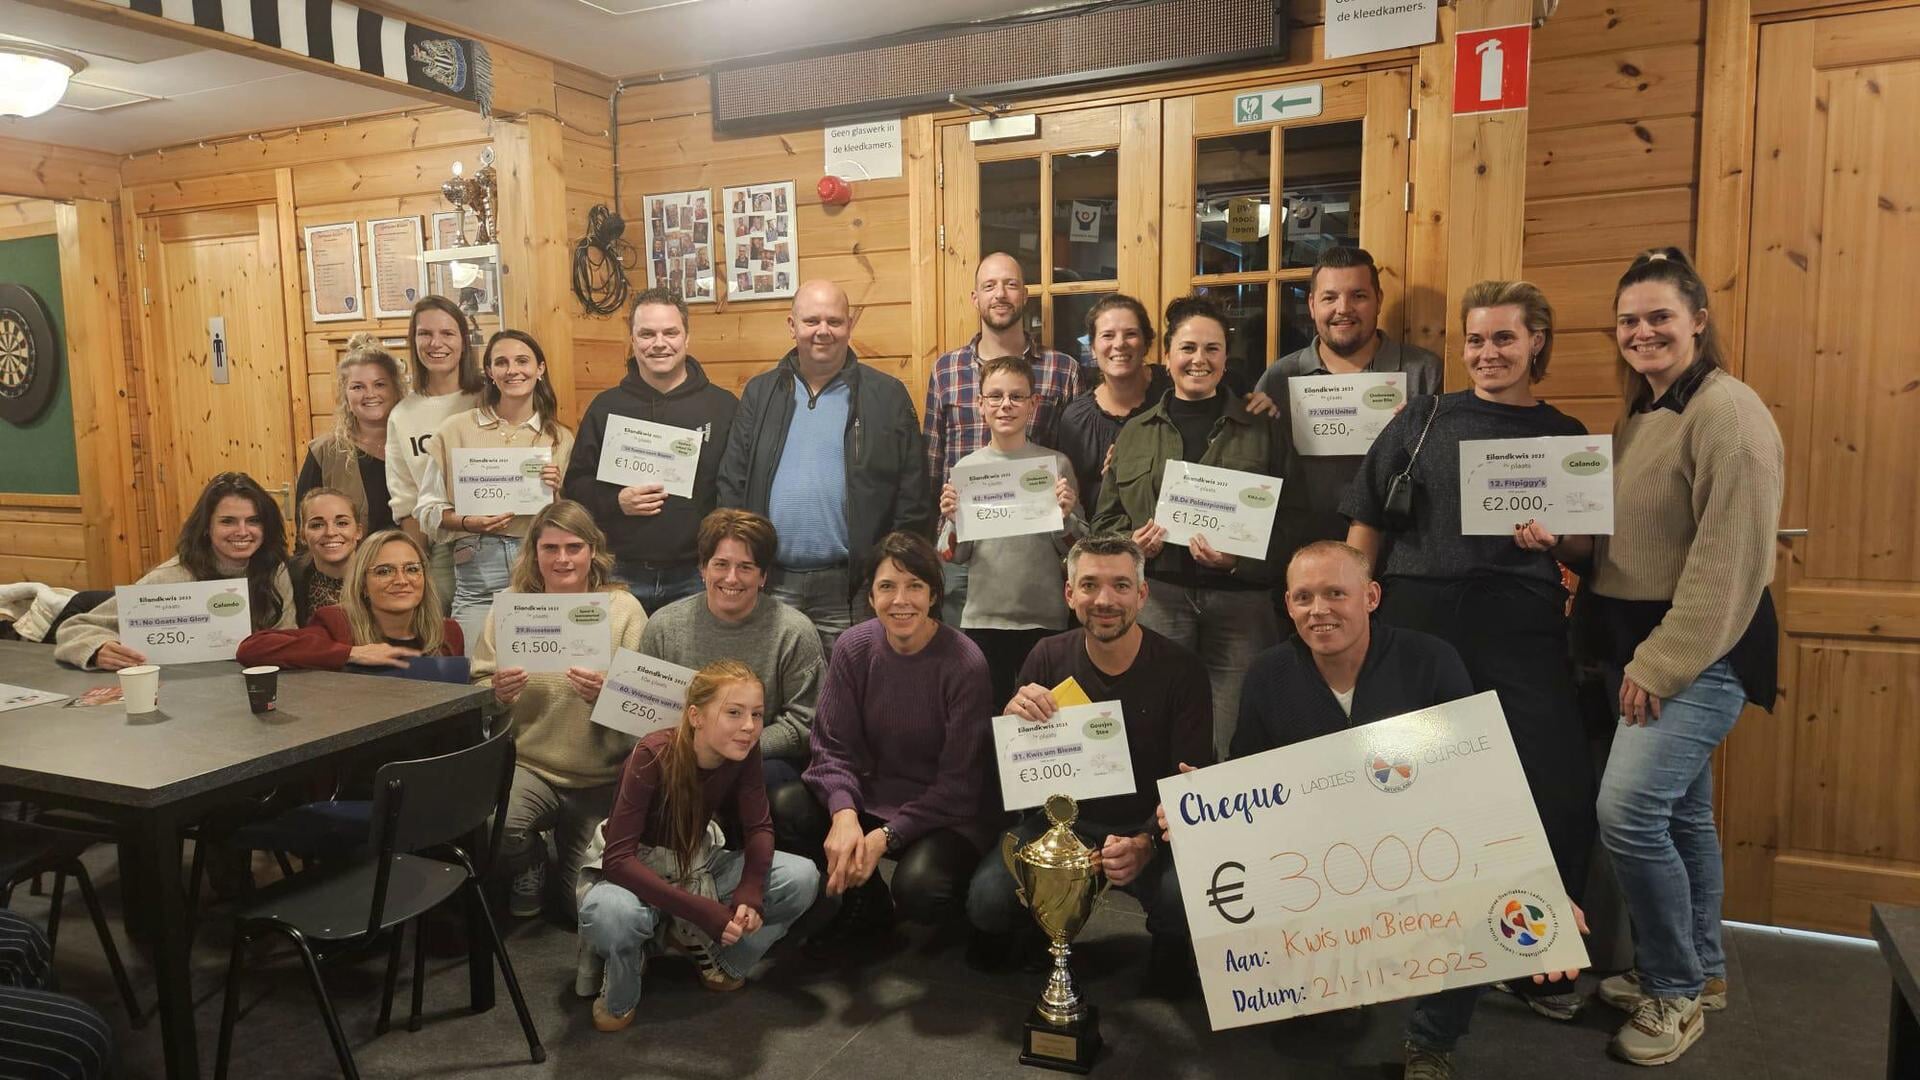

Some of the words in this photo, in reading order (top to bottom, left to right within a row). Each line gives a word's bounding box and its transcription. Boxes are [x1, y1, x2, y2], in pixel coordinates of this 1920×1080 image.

[1336, 12, 1350, 22] de
[1353, 2, 1426, 19] kleedkamers.
[1242, 113, 1258, 122] AED
[831, 129, 850, 138] Geen
[852, 124, 884, 137] glaswerk
[887, 122, 895, 132] in
[833, 145, 842, 154] de
[844, 141, 894, 152] kleedkamers.
[1313, 423, 1355, 436] €250,-
[615, 457, 660, 475] €1.000,-
[1505, 480, 1546, 488] Fitpiggy's
[474, 488, 510, 500] €250,-
[1483, 496, 1554, 512] €2.000,-
[976, 508, 1015, 520] €250,-
[1172, 511, 1224, 531] €1.250,-
[190, 616, 208, 624] Glory
[147, 632, 194, 644] €250,-
[512, 641, 566, 654] €1.500,-
[637, 666, 673, 682] Eilandkwis
[621, 700, 662, 723] €250,-
[1018, 724, 1054, 733] Eilandkwis
[1026, 752, 1043, 760] Kwis
[1020, 763, 1080, 782] €3.000,-
[1180, 783, 1291, 825] Cheque
[1424, 736, 1491, 764] CIRCLE
[1206, 861, 1255, 924] €
[1224, 948, 1270, 973] Aan:
[1282, 929, 1338, 958] Kwis
[1344, 926, 1371, 946] um
[1232, 986, 1306, 1014] Datum:
[1313, 952, 1488, 998] 21-11-2025
